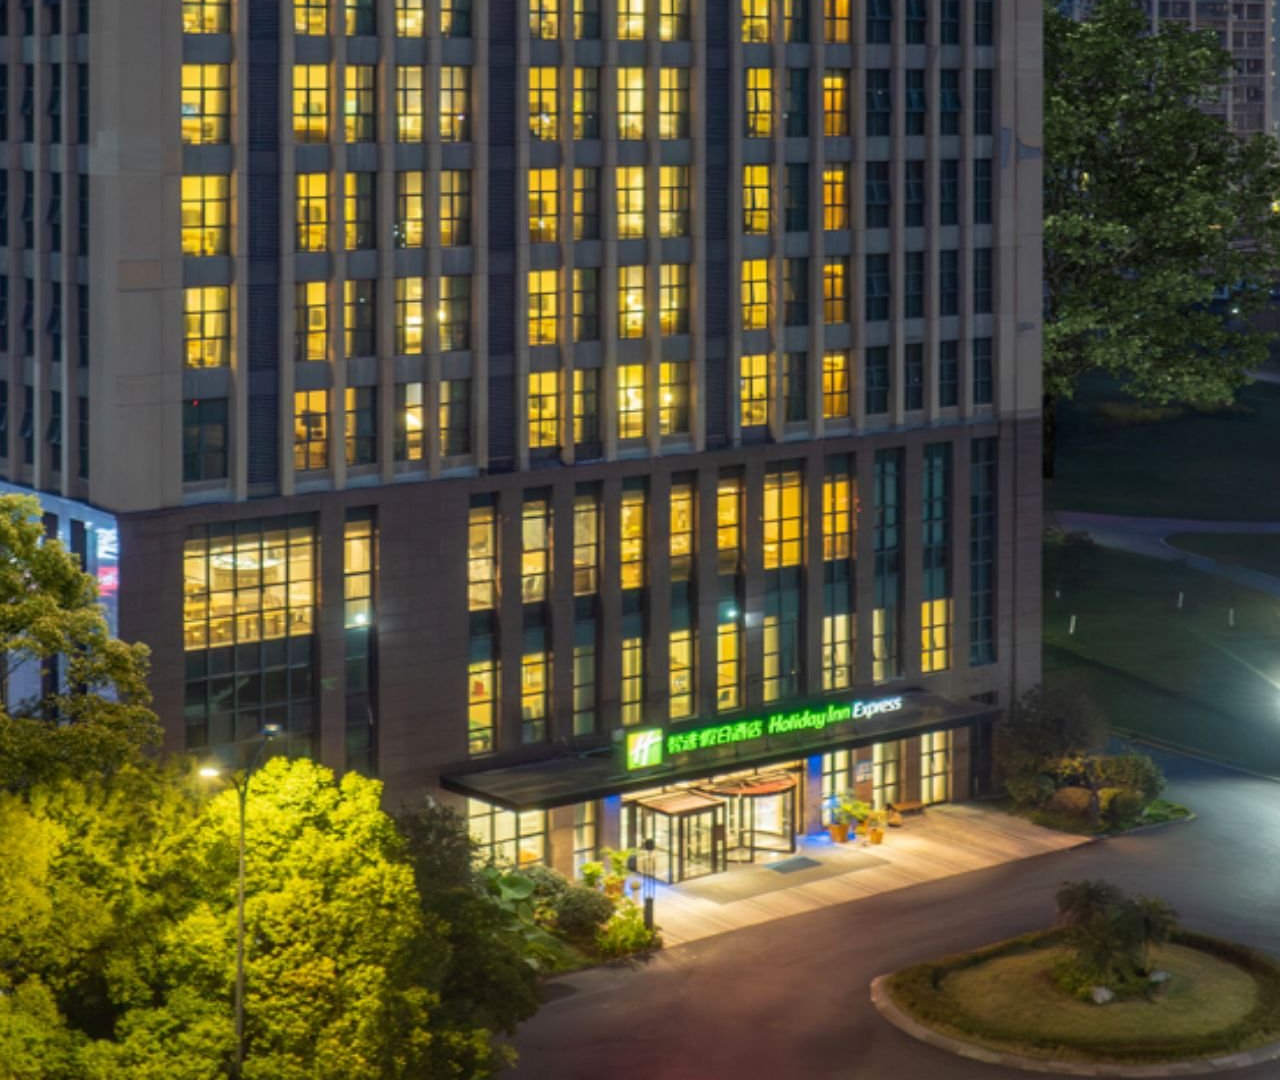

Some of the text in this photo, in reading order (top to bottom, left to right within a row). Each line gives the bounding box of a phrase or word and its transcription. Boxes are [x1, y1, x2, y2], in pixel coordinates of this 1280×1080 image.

[768, 697, 902, 734] Holiday Inn Express
